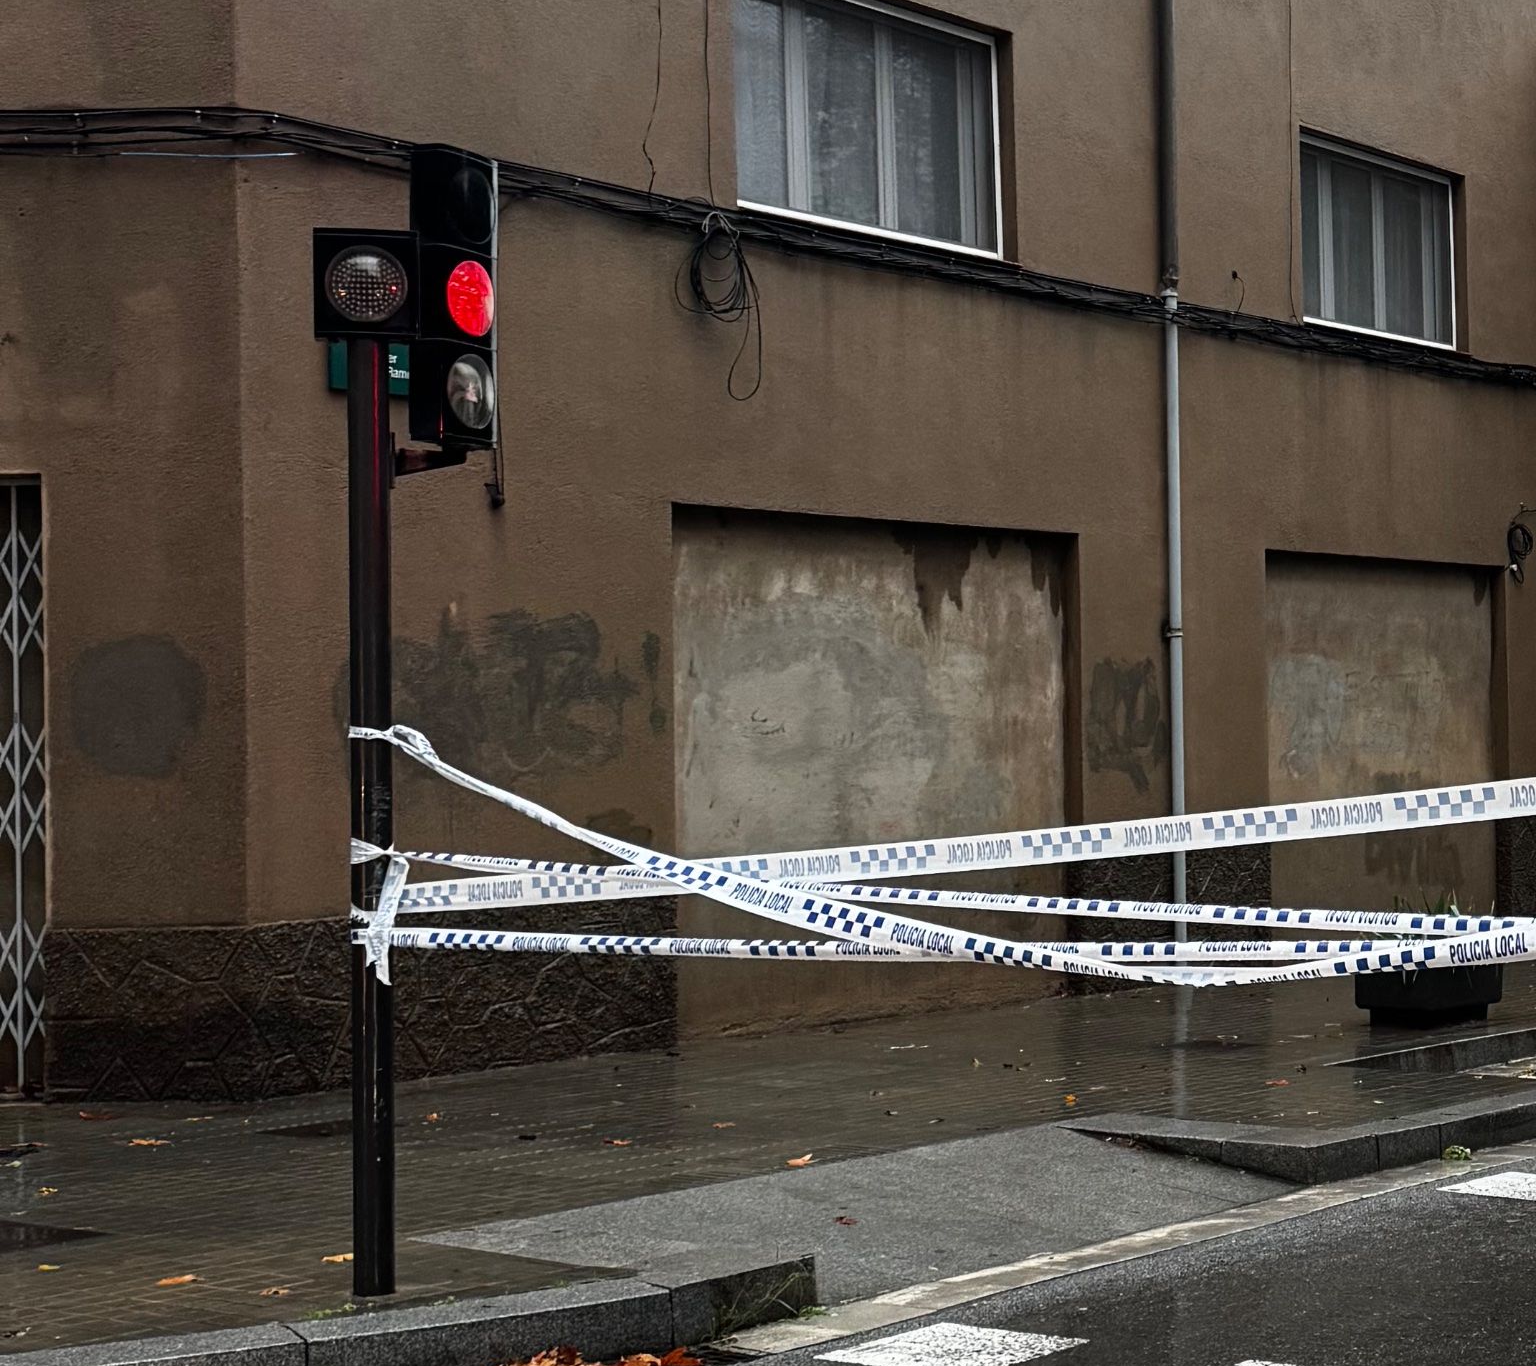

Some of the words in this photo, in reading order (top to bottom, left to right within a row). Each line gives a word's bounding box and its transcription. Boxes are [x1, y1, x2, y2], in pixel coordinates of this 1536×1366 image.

[729, 882, 764, 907] POLICIA
[763, 889, 794, 914] LOCAL
[890, 922, 927, 951] POLICIA
[926, 929, 955, 954] LOCAL
[1449, 939, 1493, 965] POLICIA
[1495, 932, 1529, 959] LOCAL
